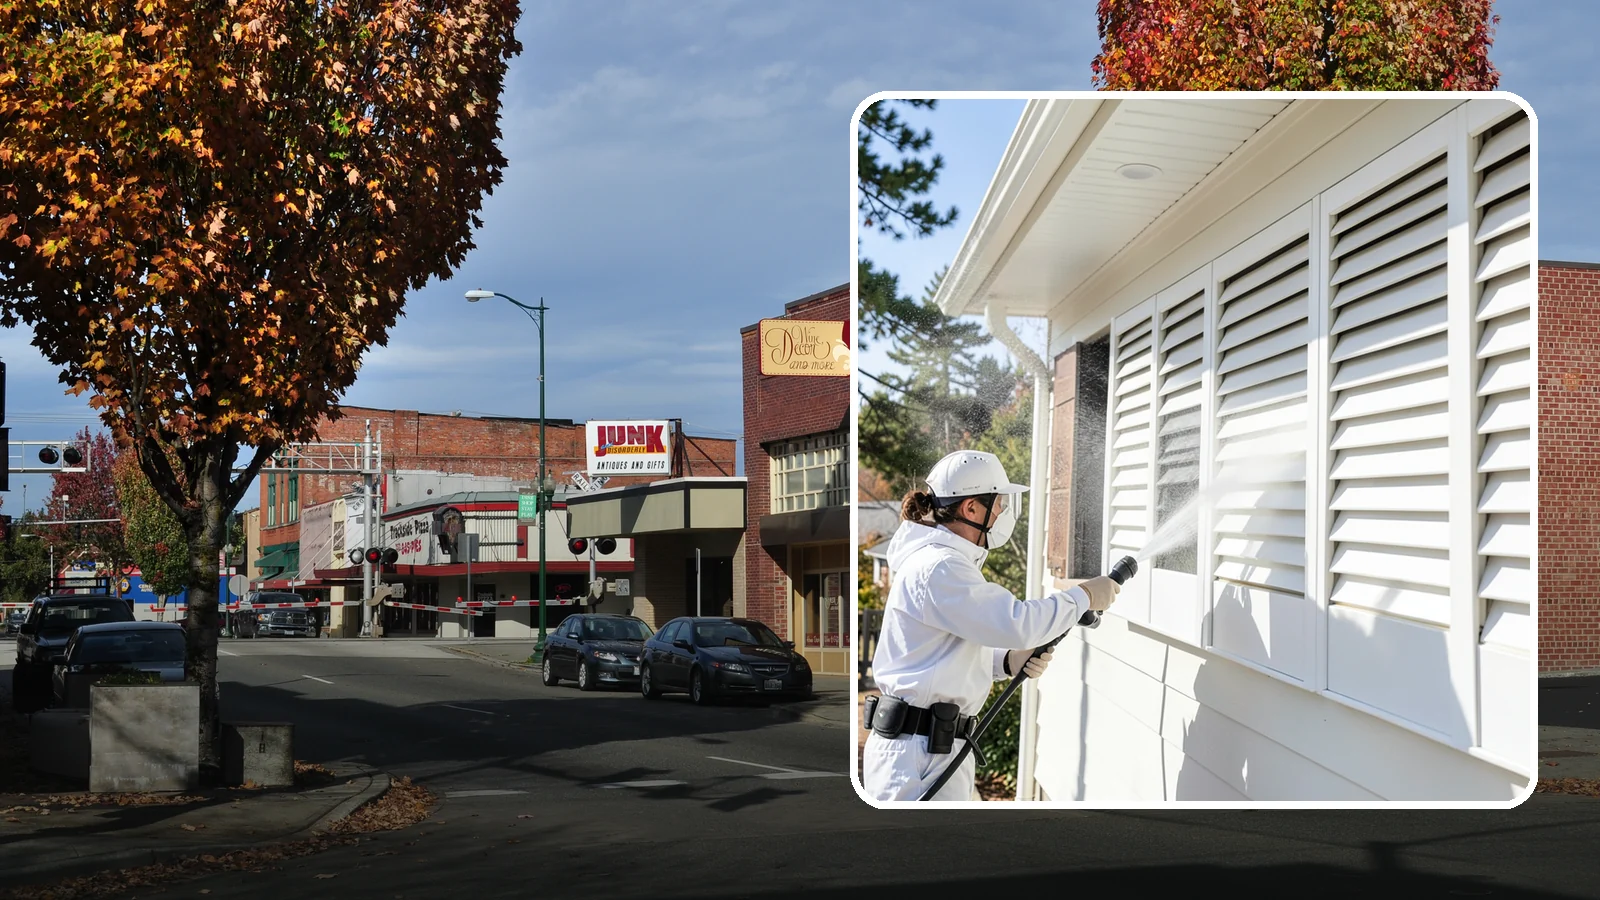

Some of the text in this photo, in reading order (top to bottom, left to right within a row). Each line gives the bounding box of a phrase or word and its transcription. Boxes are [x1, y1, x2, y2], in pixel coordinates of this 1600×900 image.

[595, 425, 665, 457] JUNK
[607, 446, 646, 454] DISORDERLY
[596, 460, 666, 470] ANTIQUES AND GIFTS
[390, 519, 429, 539] Trackside Pizza
